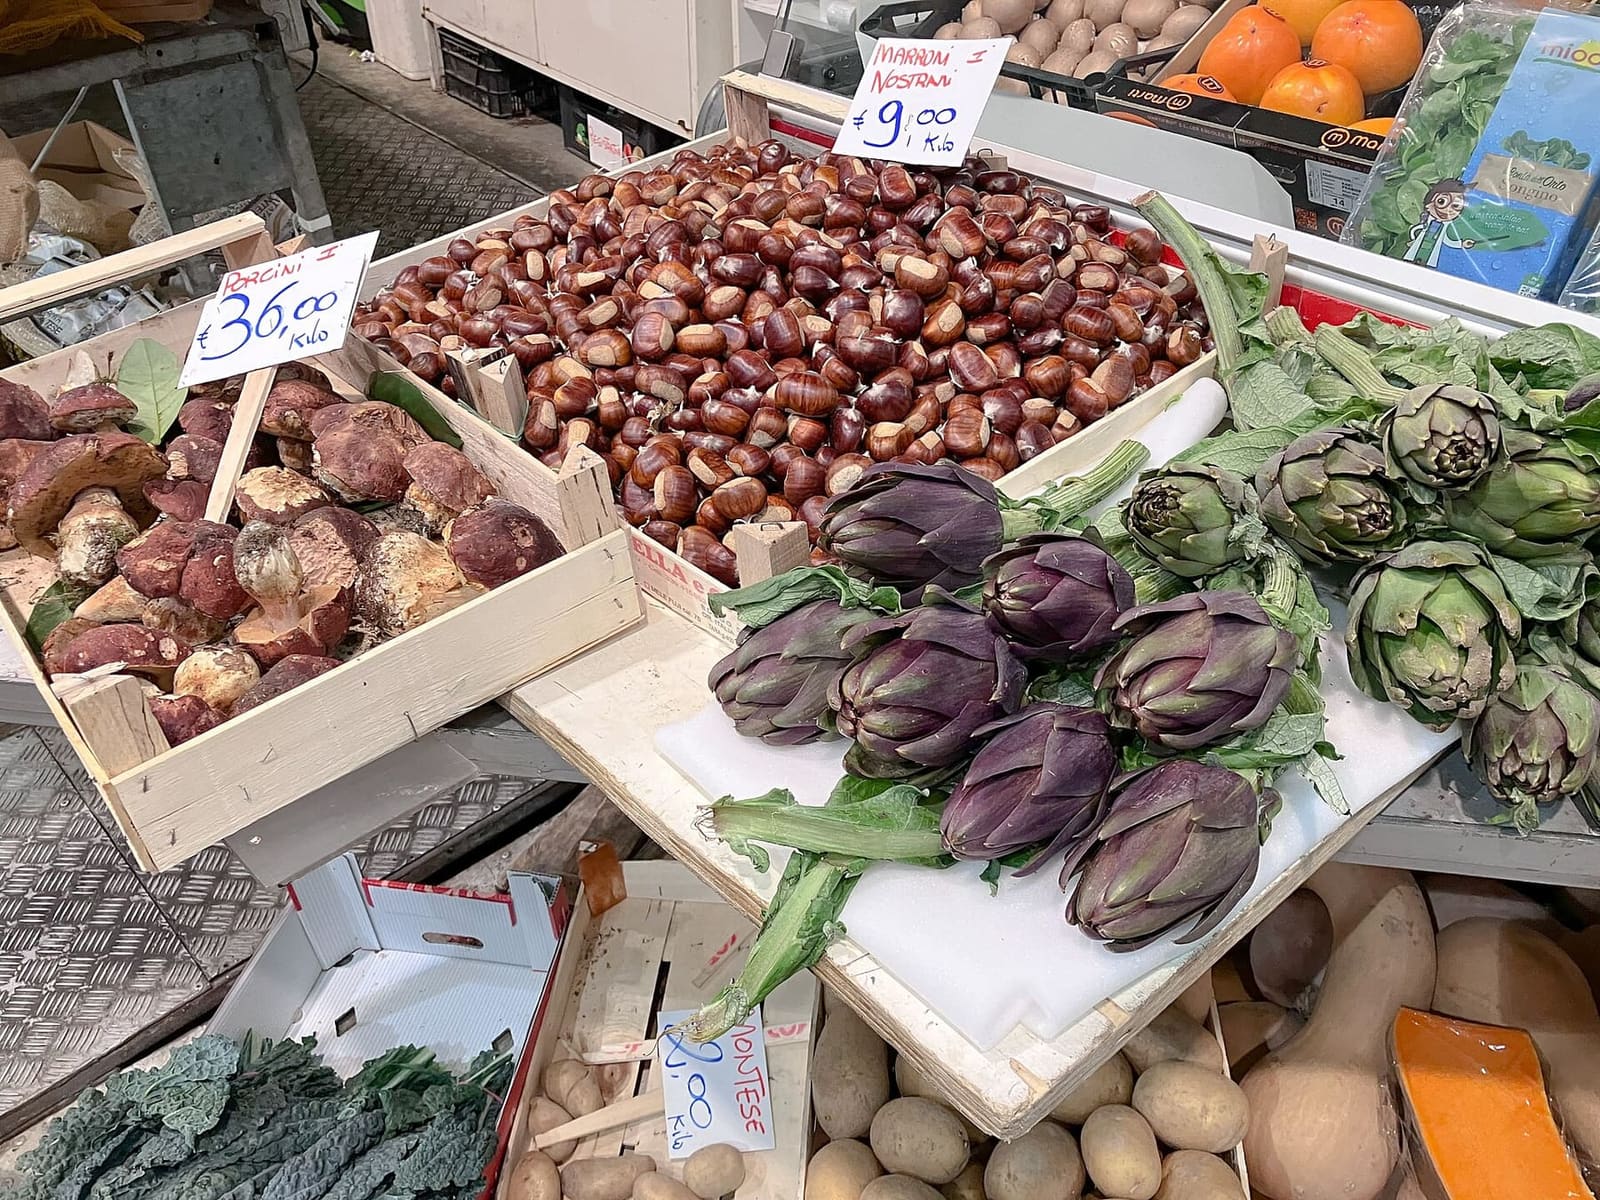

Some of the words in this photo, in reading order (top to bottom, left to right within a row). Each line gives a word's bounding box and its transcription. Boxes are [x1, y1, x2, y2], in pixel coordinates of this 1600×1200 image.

[923, 132, 955, 152] Kilo
[1349, 135, 1384, 151] mar
[222, 255, 304, 296] PORCINI
[289, 319, 328, 350] Kilo
[667, 1114, 693, 1150] Kilo
